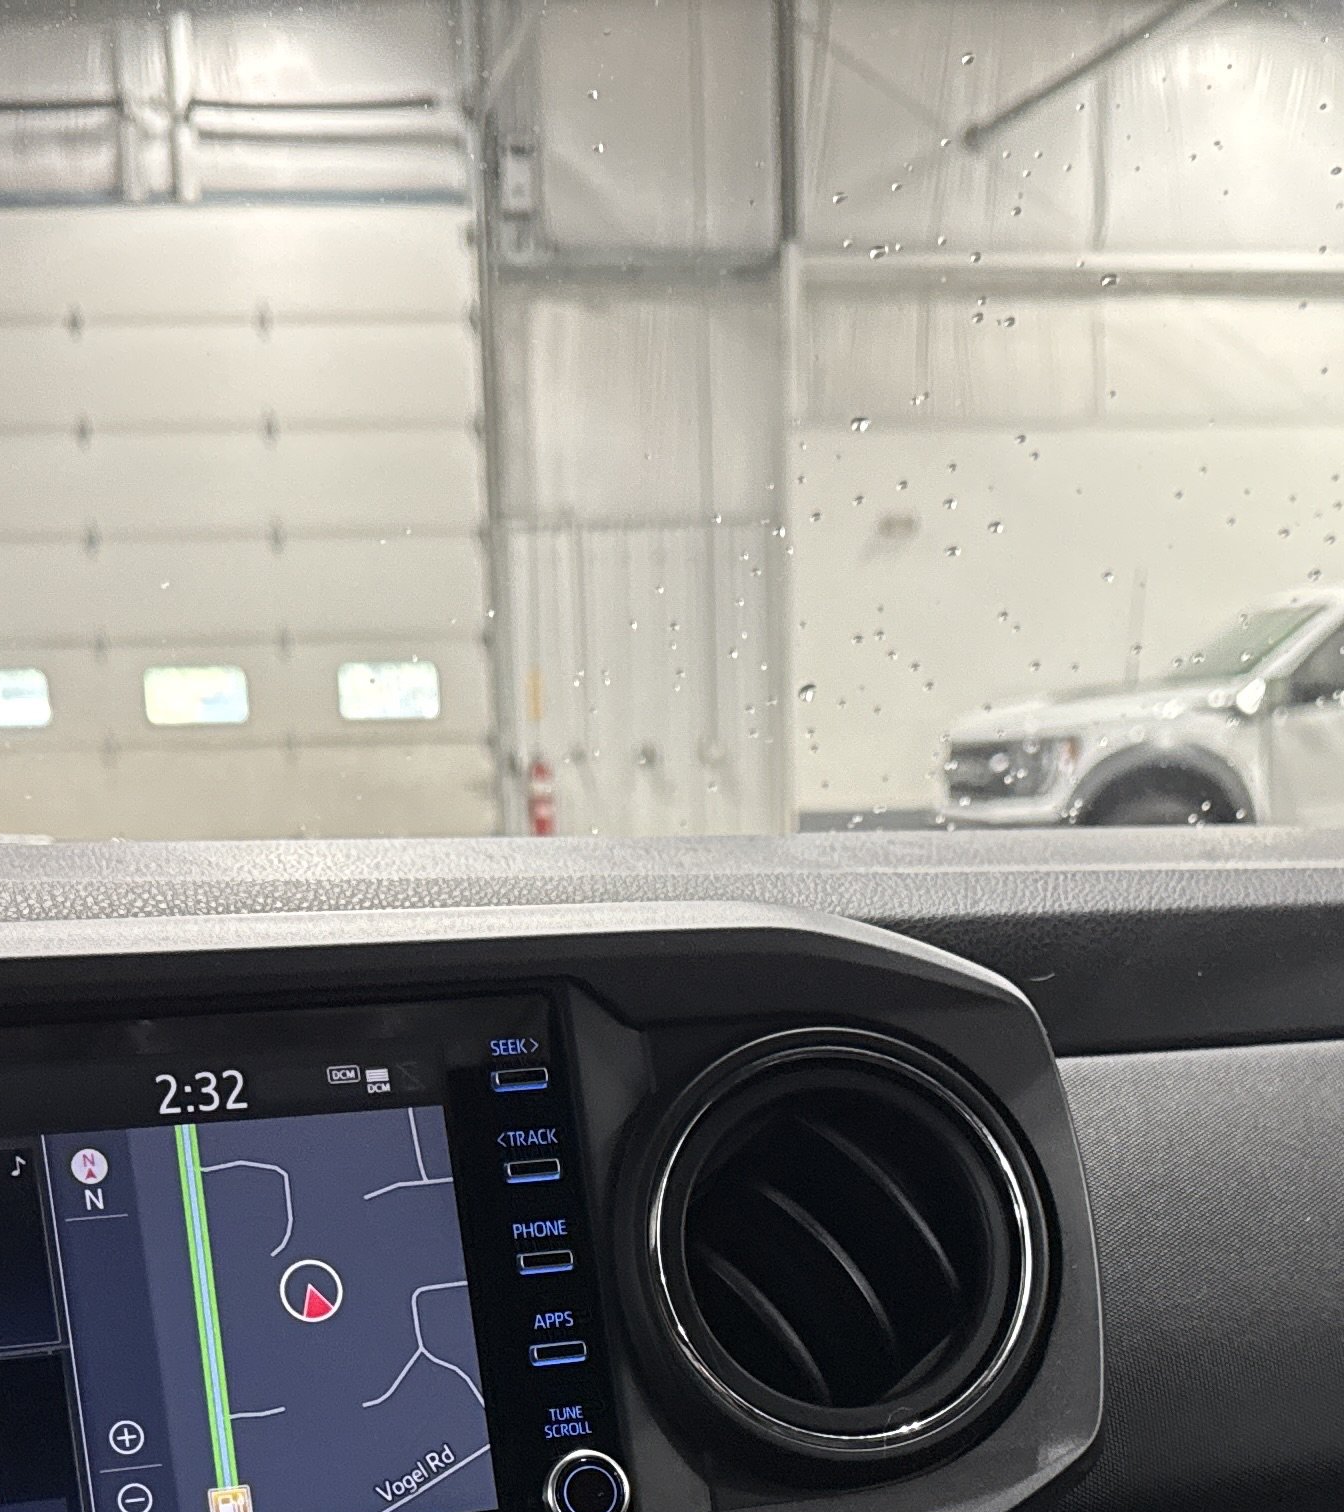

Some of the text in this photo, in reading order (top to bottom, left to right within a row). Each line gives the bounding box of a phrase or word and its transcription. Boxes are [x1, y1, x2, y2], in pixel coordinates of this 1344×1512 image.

[332, 1069, 356, 1080] DCM
[156, 1070, 247, 1114] 2:32
[367, 1083, 391, 1094] DCM
[85, 1189, 104, 1210] N
[513, 1220, 566, 1238] PHONE
[535, 1311, 573, 1329] APPS
[549, 1406, 582, 1421] TUNE
[545, 1420, 592, 1438] SCROLL
[375, 1444, 455, 1502] Vogel Rd
